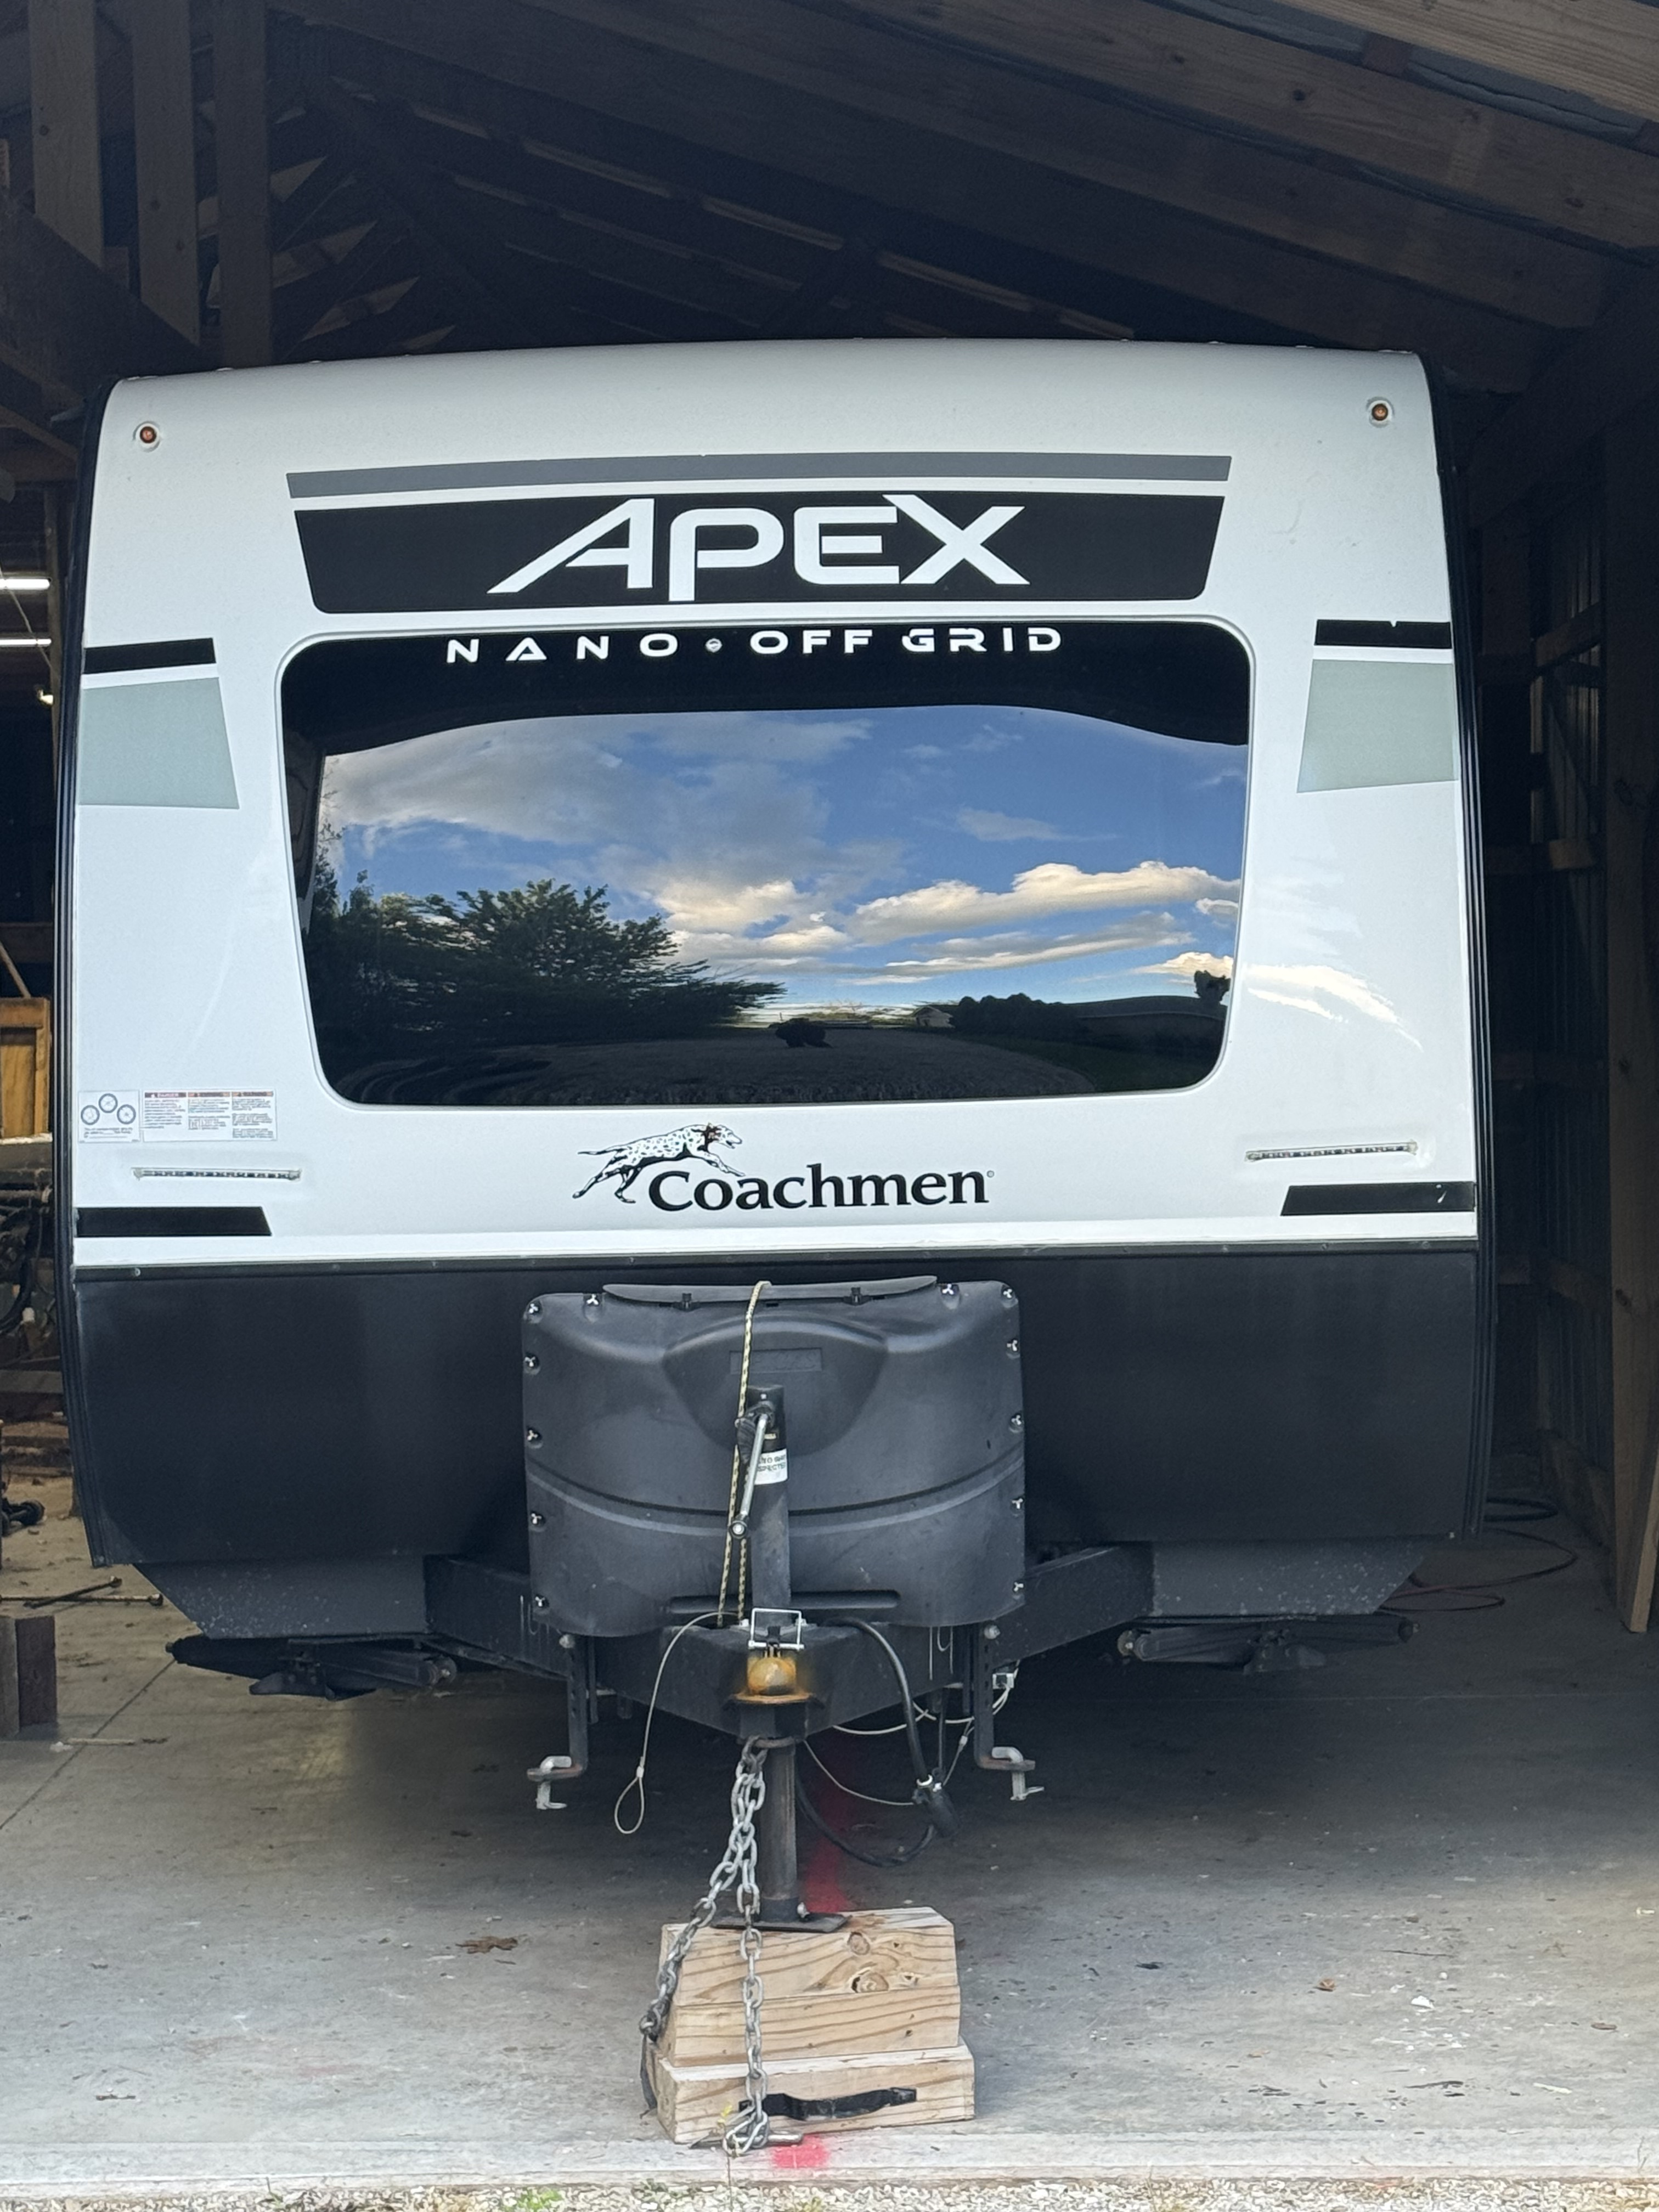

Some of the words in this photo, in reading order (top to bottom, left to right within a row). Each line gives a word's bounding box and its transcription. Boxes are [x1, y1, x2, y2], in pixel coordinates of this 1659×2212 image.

[487, 493, 1030, 602] APEX
[447, 633, 678, 663] NANO
[750, 629, 873, 654] OFF
[901, 627, 1061, 652] GRID
[648, 1163, 989, 1212] Coachmen
